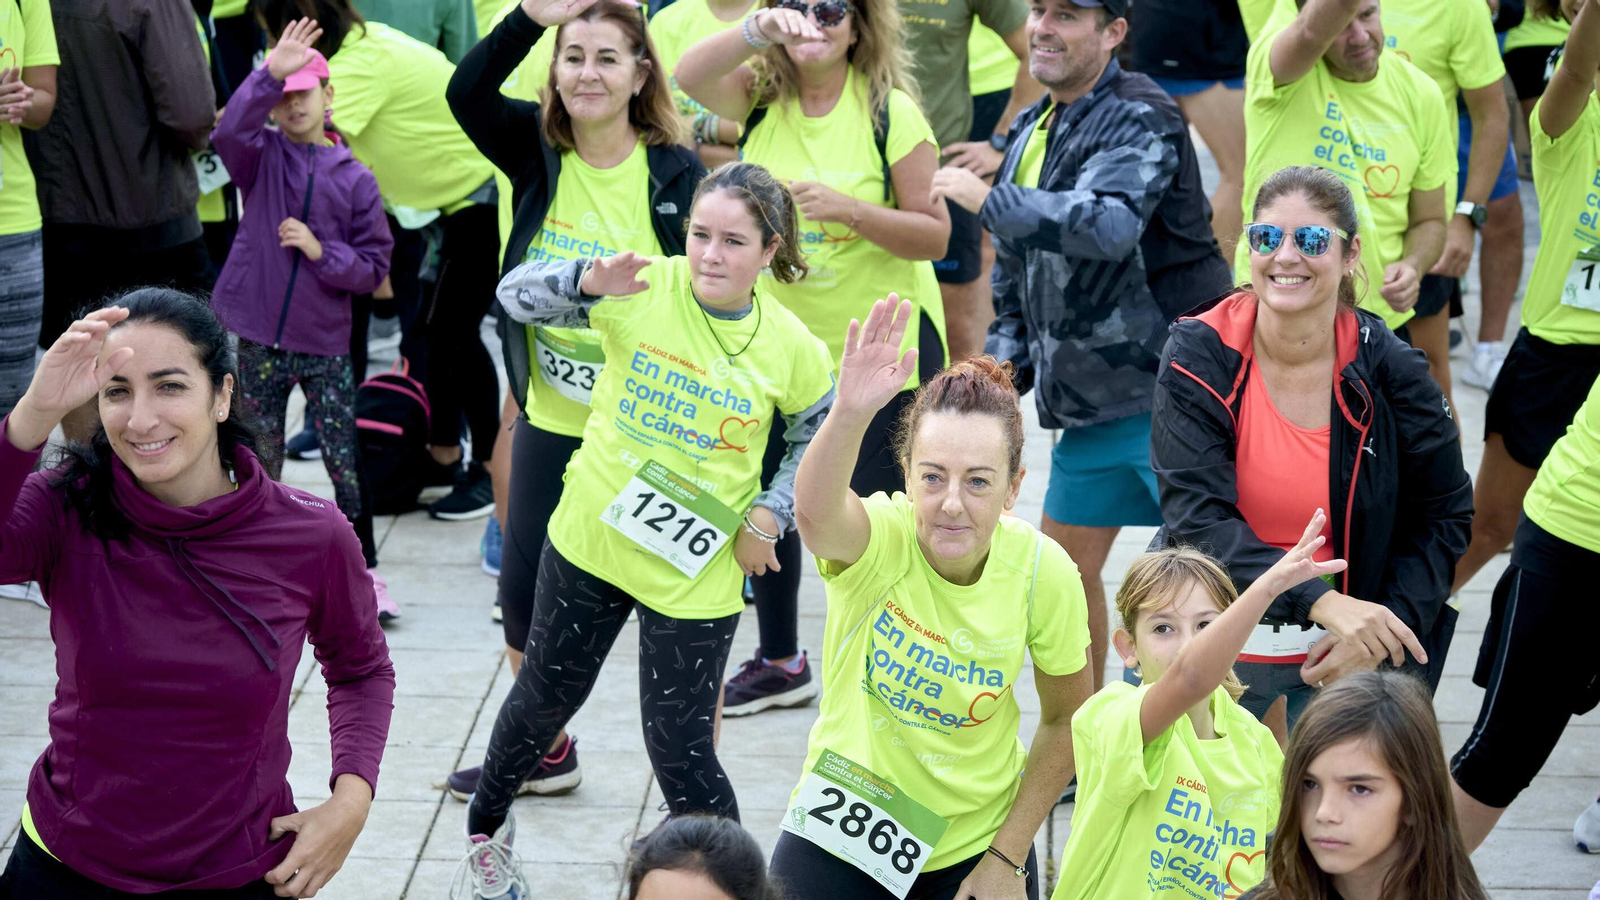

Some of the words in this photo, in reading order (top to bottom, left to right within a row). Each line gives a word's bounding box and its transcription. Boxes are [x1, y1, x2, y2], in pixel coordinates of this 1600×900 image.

[1314, 144, 1334, 162] el
[1579, 212, 1598, 230] el
[646, 343, 668, 359] CÁDIZ
[668, 353, 679, 362] EN
[679, 357, 707, 376] MARCHA
[626, 378, 698, 420] contra
[630, 351, 660, 380] En
[664, 370, 752, 415] marcha
[619, 398, 637, 420] el
[641, 411, 721, 450] cáncer
[646, 467, 668, 484] contra
[290, 494, 325, 508] QUECHUA
[632, 492, 718, 556] 1216
[873, 608, 906, 649] En
[886, 600, 895, 611] IX
[894, 607, 916, 628] CÁDIZ
[878, 682, 970, 729] cáncer
[898, 718, 920, 728] CONTRA
[824, 761, 852, 778] contra
[854, 776, 863, 784] el
[826, 753, 852, 770] Cádiz
[851, 766, 862, 774] en
[863, 772, 894, 794] marcha
[1176, 776, 1186, 786] IX
[1186, 780, 1207, 794] CÁDIZ
[1165, 788, 1202, 822] En
[808, 788, 921, 875] 2868
